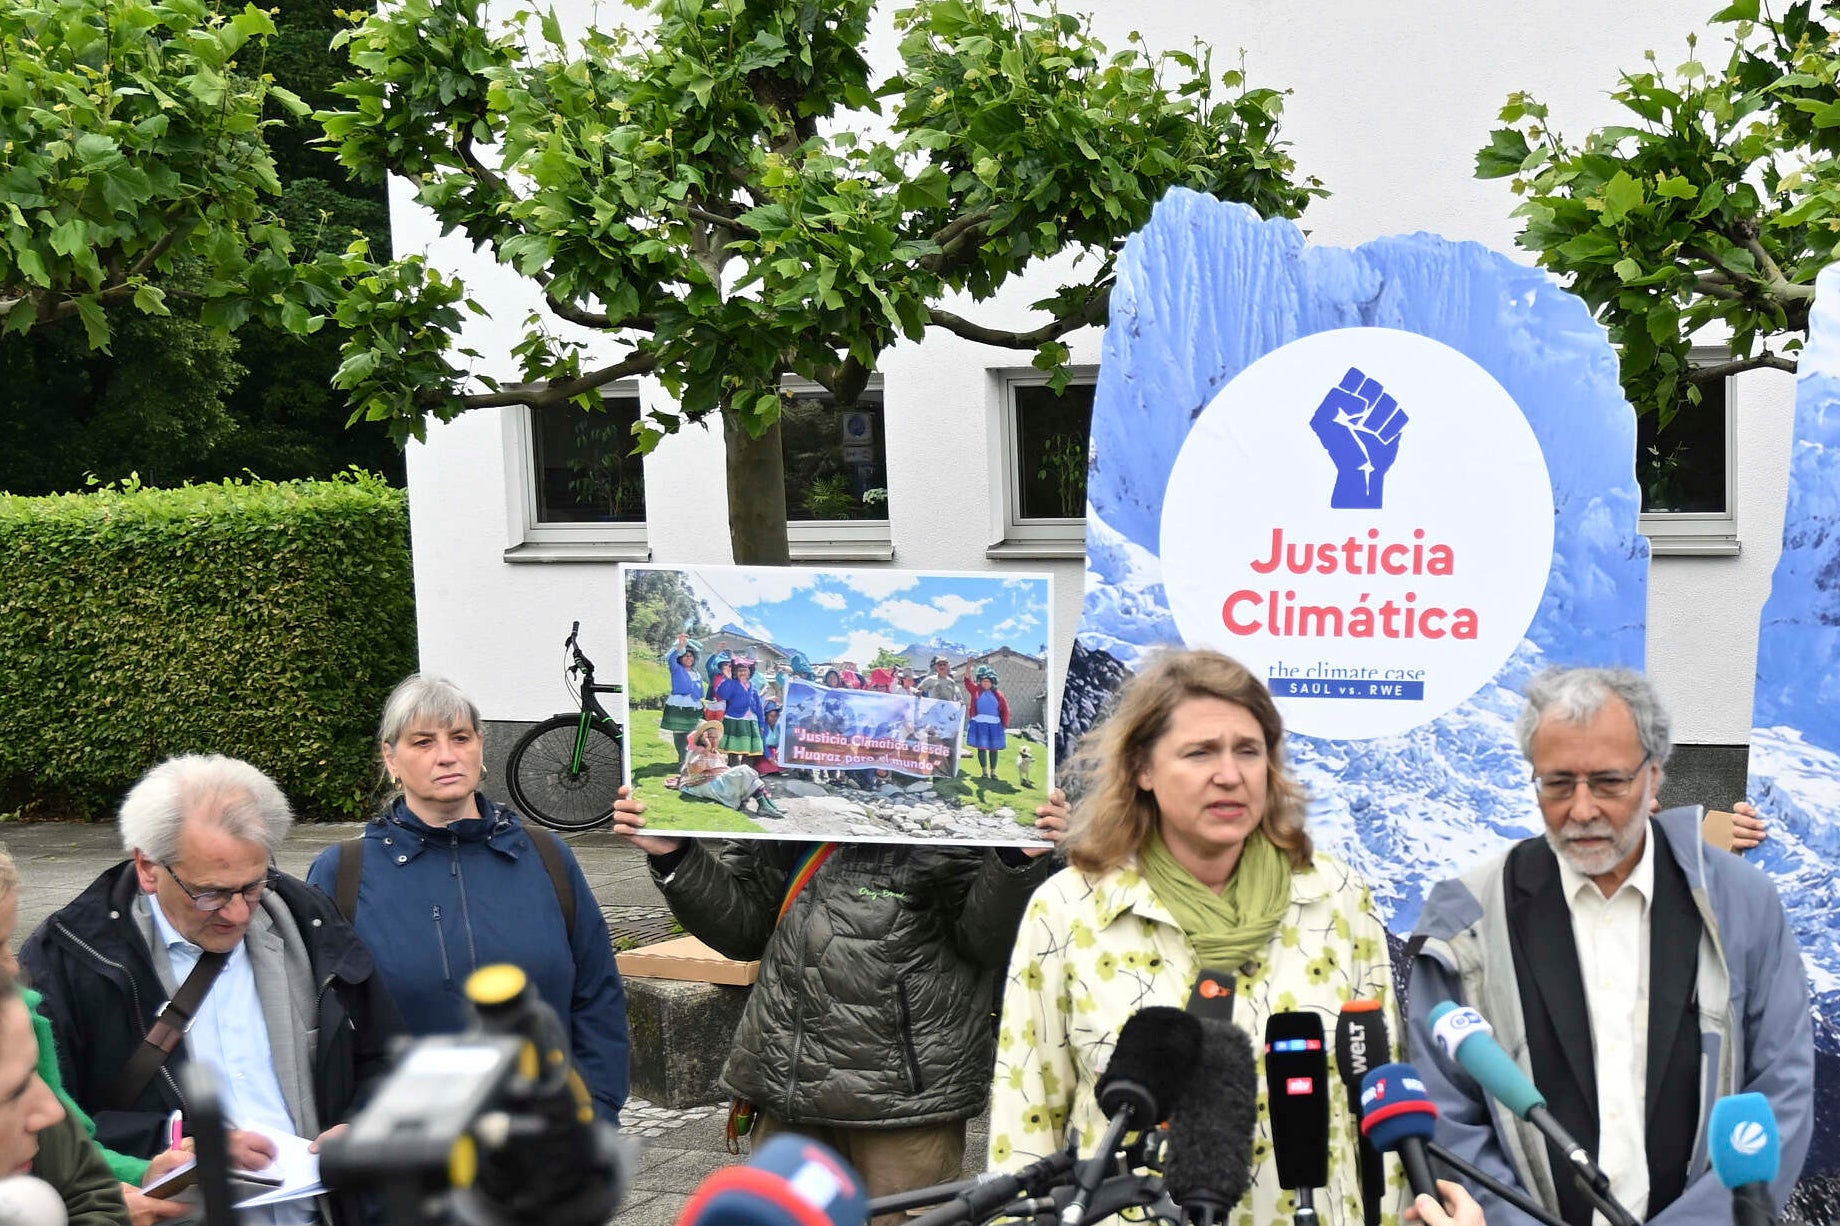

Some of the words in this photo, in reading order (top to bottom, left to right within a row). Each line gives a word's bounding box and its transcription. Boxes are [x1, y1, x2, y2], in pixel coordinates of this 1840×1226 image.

[1250, 528, 1454, 575] Justicia
[1222, 589, 1479, 640] Climática
[1269, 661, 1300, 678] the
[1306, 661, 1379, 680] climate
[1384, 668, 1426, 681] case
[1339, 686, 1362, 696] vs.
[1369, 684, 1403, 696] RWE
[793, 745, 841, 763] Huaraz
[912, 740, 950, 757] desde
